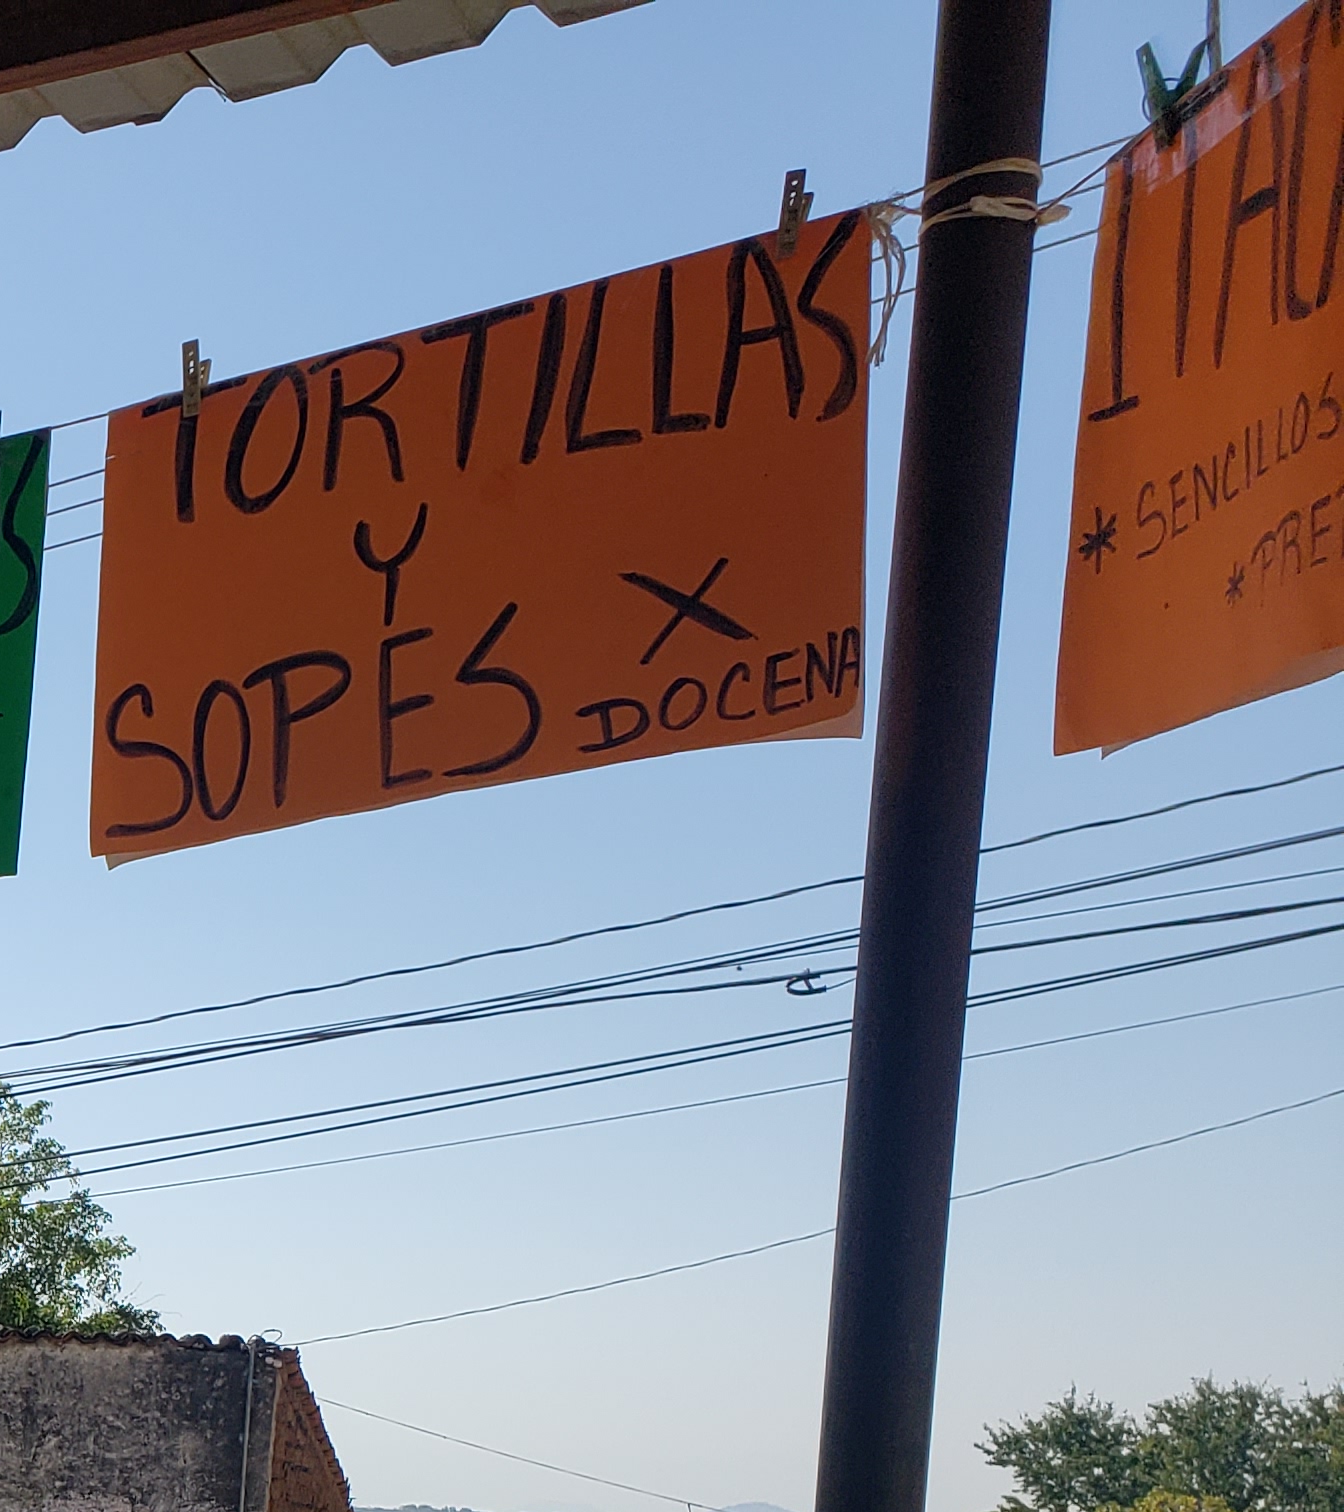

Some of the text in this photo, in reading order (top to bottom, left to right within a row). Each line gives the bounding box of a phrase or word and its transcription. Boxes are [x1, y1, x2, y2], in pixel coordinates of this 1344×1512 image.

[142, 208, 862, 523] TORTILLAS
[1137, 372, 1343, 560] SENCILLOS
[353, 502, 427, 626] Y
[576, 558, 859, 753] X DOCENA
[106, 603, 542, 836] SOPES
